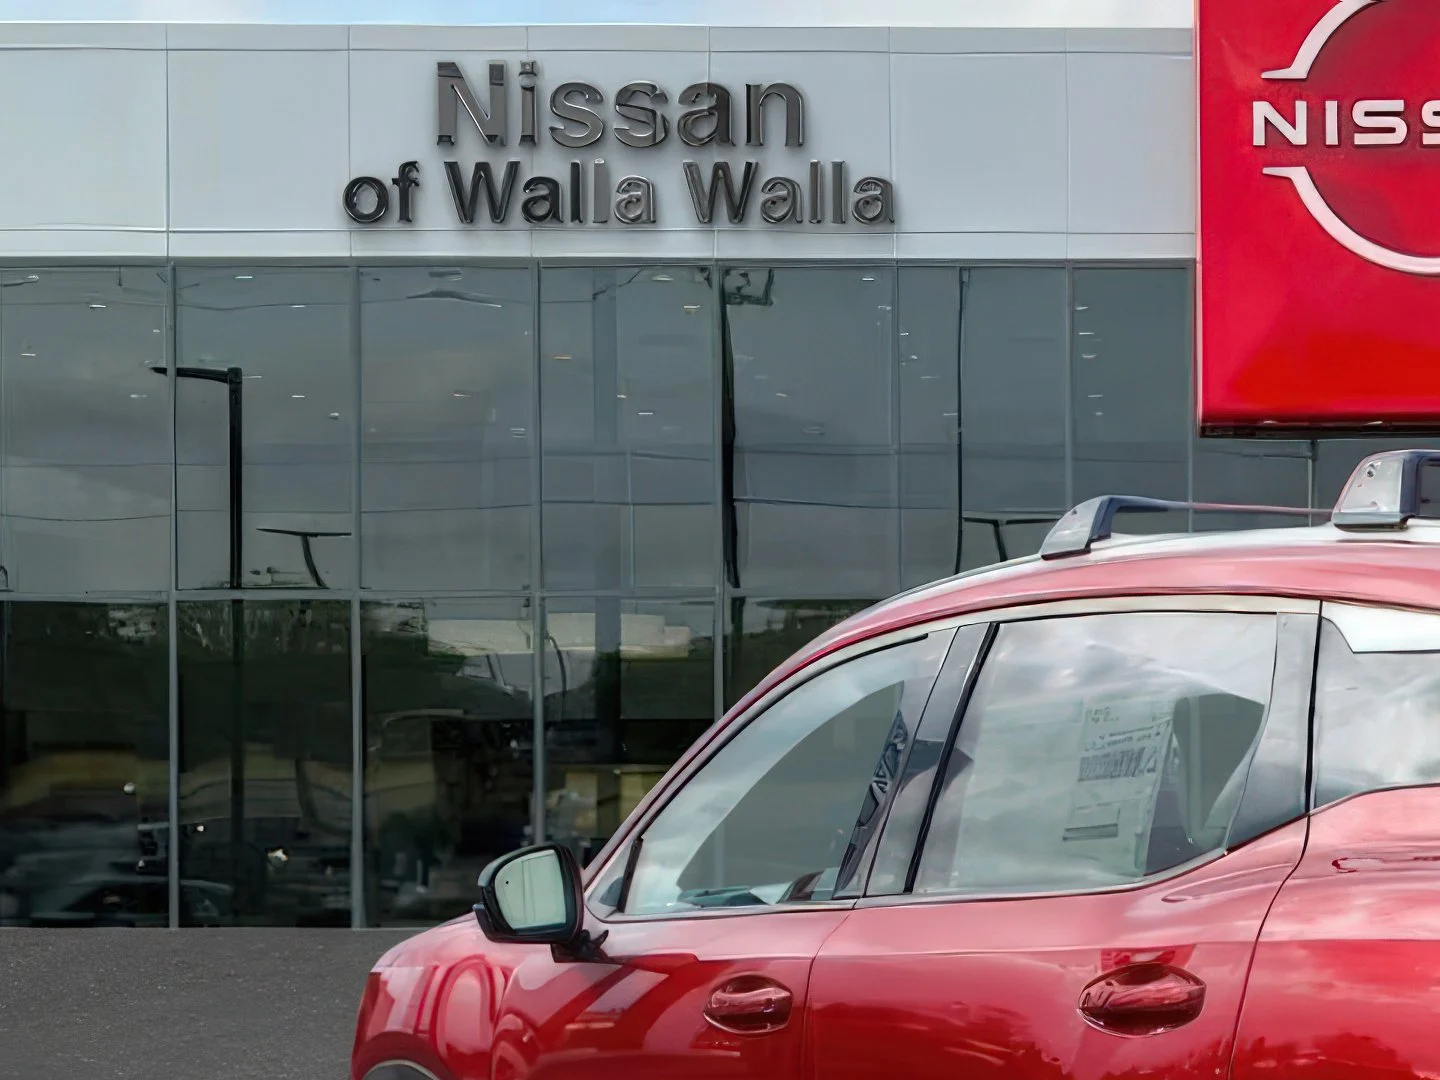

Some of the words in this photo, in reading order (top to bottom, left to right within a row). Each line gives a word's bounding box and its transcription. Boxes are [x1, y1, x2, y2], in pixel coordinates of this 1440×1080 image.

[436, 60, 804, 148] Nissan
[342, 160, 420, 223] of
[443, 159, 657, 224] Walla
[682, 159, 895, 224] Walla
